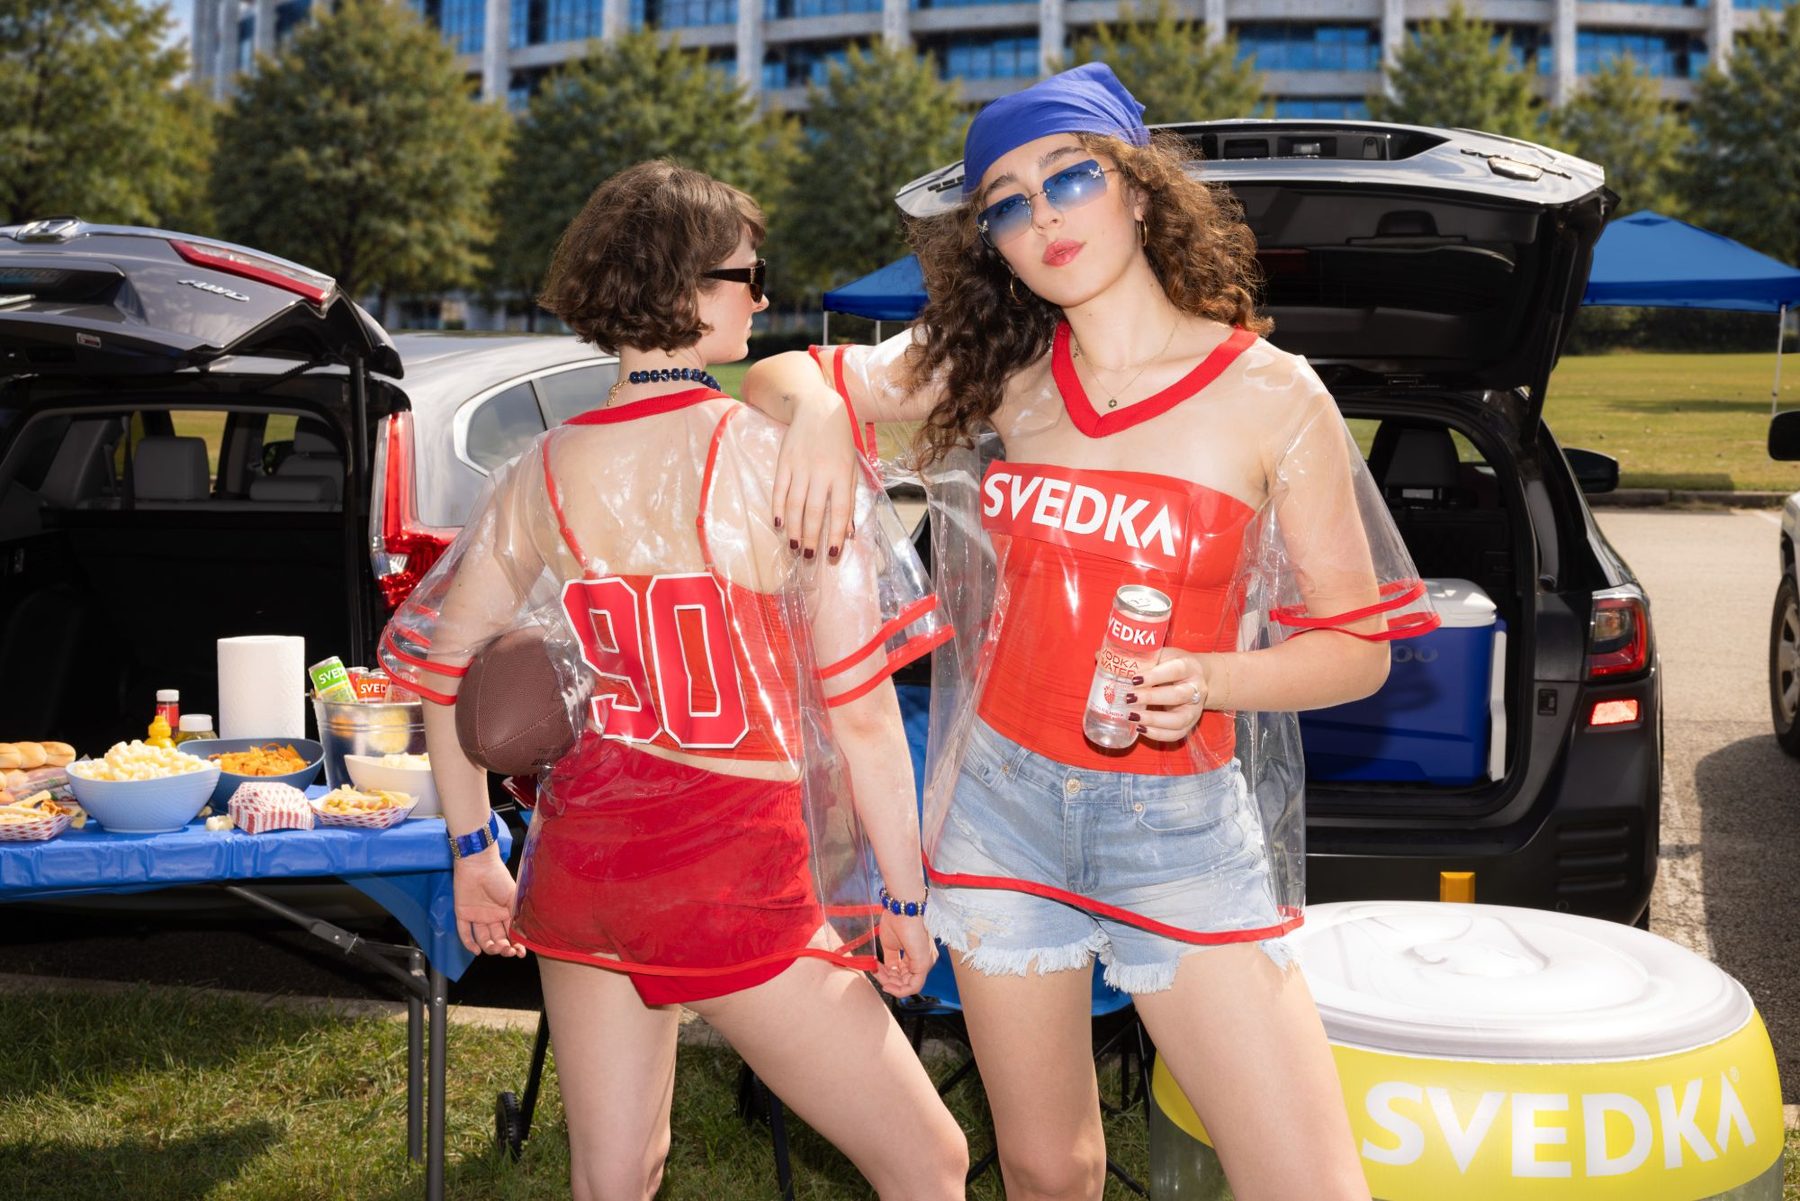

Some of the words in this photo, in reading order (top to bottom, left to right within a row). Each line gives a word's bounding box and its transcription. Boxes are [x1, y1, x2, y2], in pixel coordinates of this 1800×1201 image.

[983, 472, 1176, 557] SVEDKA
[561, 572, 749, 749] 90
[1361, 1072, 1757, 1179] SVEDKA
